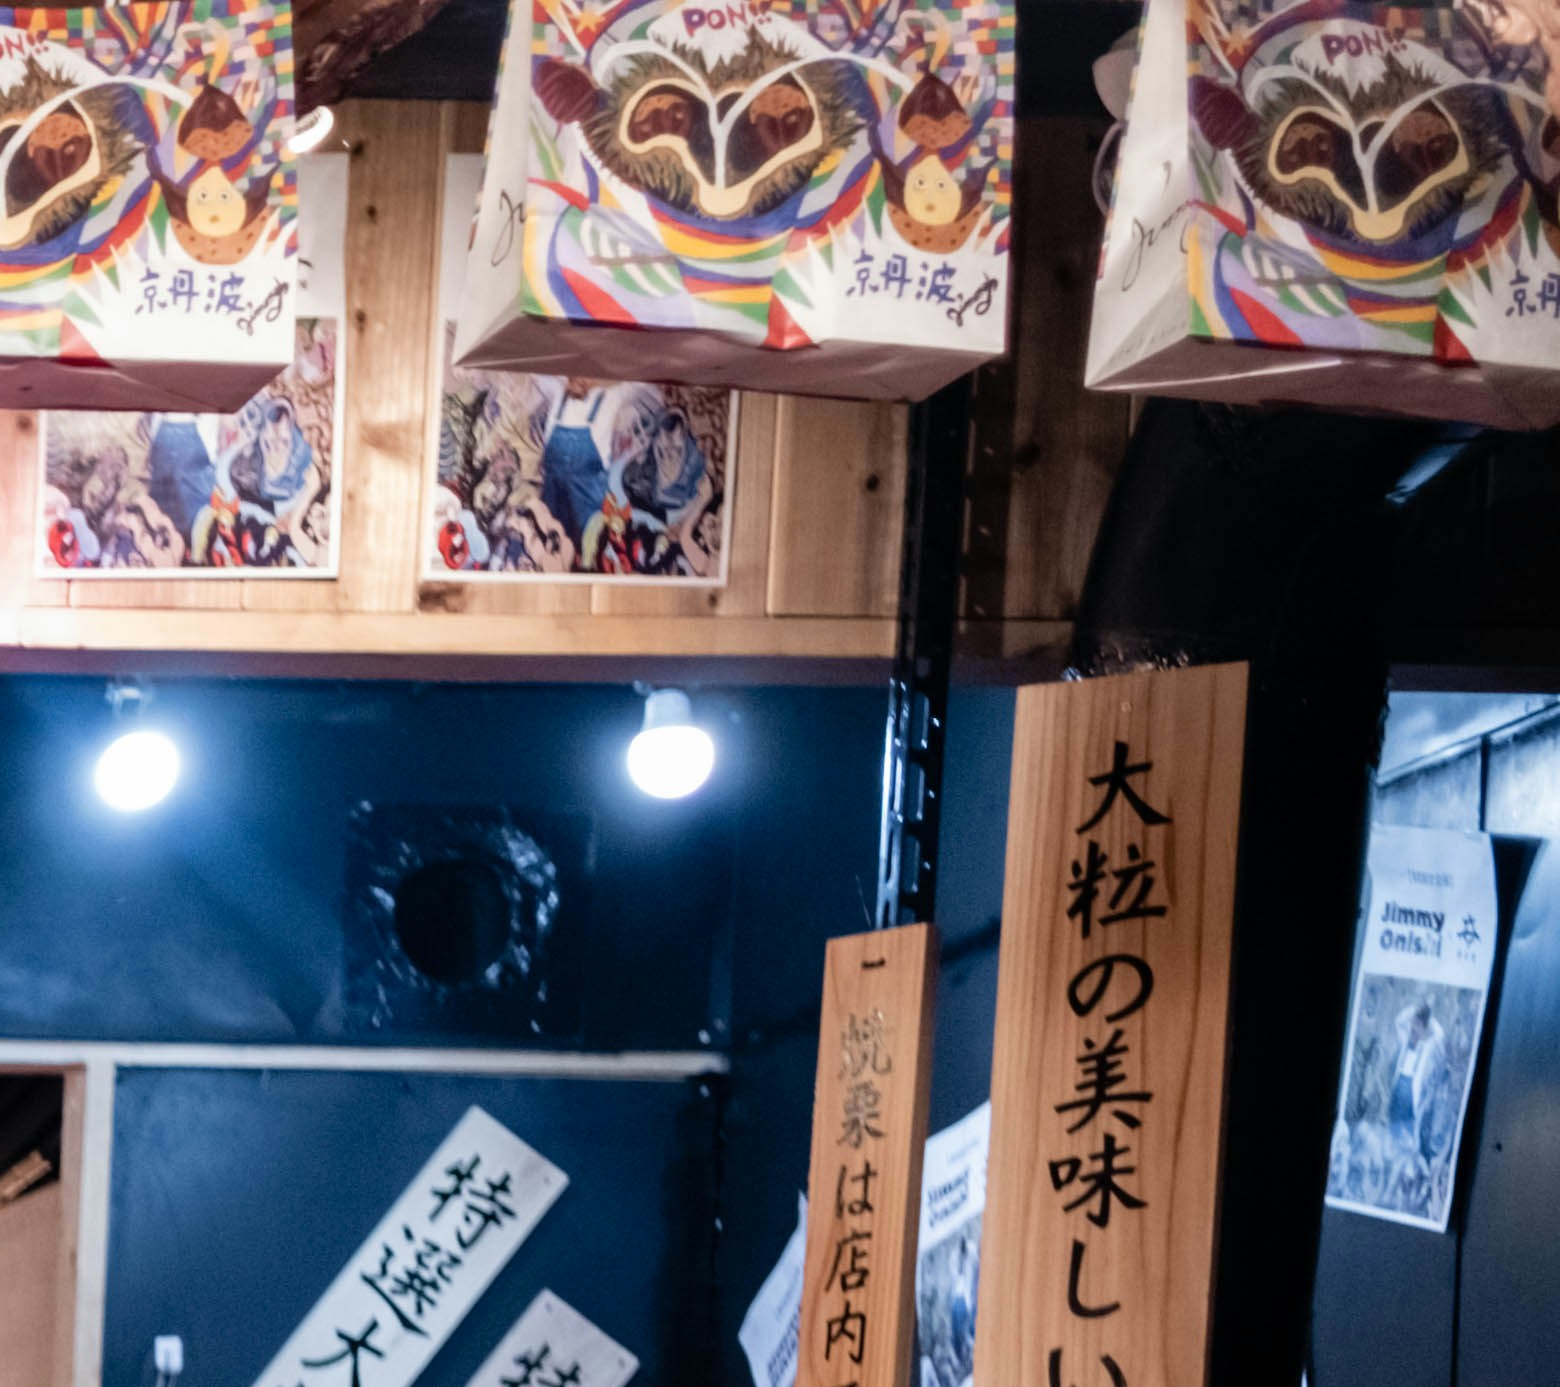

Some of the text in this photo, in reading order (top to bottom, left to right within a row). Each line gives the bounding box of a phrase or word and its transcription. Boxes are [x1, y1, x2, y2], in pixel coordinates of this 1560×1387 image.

[682, 2, 773, 36] PON!!
[1319, 28, 1409, 64] PON!!
[135, 267, 250, 316] 京丹波
[846, 248, 958, 304] 京丹波
[1381, 902, 1445, 933] Jimmy
